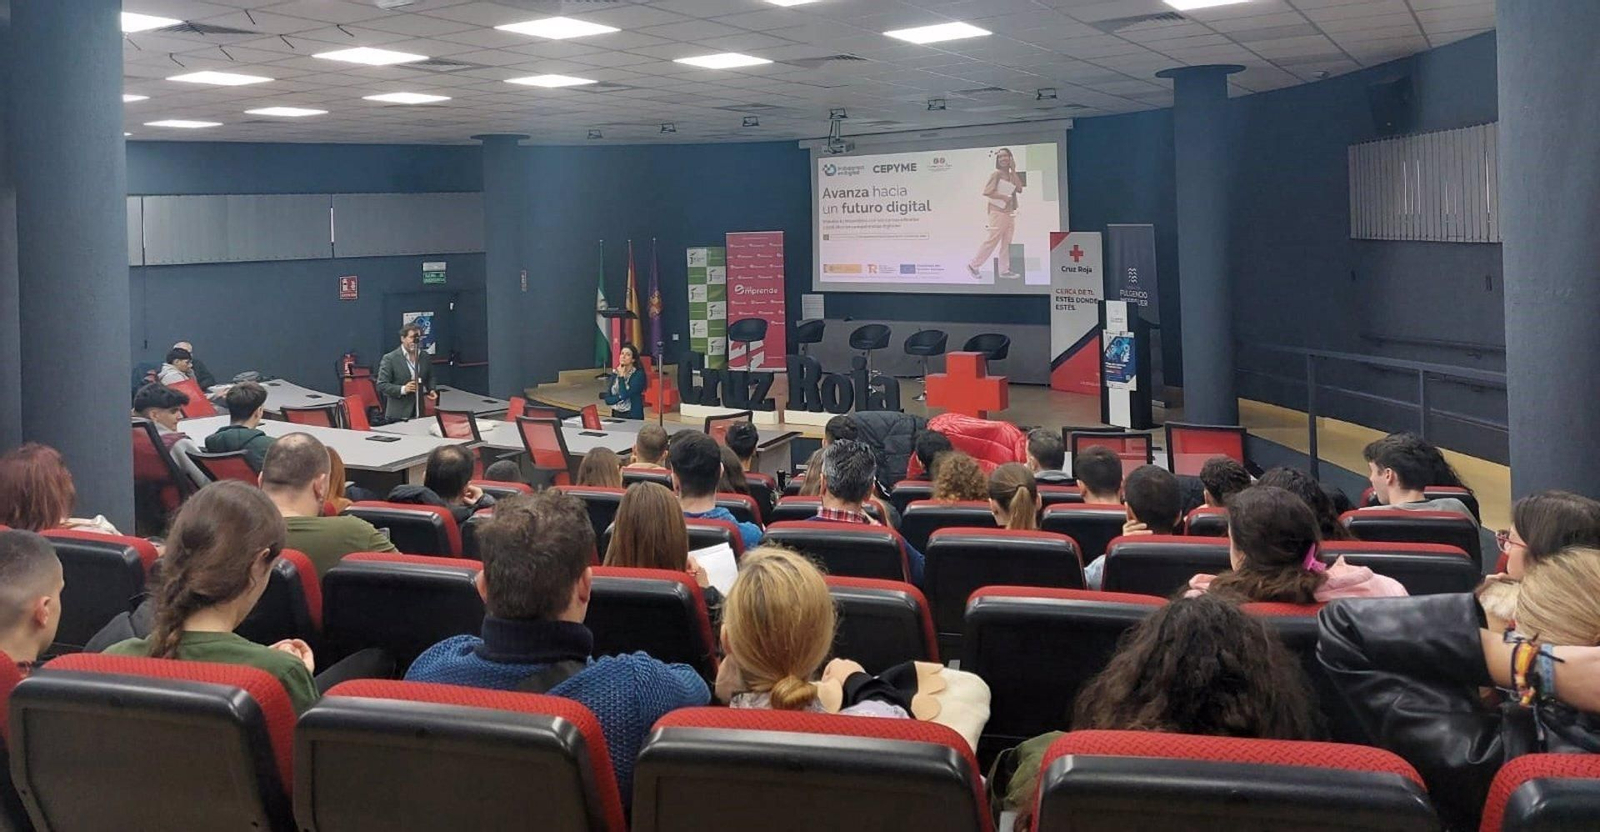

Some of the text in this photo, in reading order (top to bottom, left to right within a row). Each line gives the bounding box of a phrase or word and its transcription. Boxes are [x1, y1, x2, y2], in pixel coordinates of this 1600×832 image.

[872, 163, 917, 174] CEPYME
[822, 184, 908, 199] Avanza hacia
[822, 200, 932, 215] un futuro digital
[1061, 265, 1093, 275] Cruz Roja
[1055, 288, 1077, 296] CERCA
